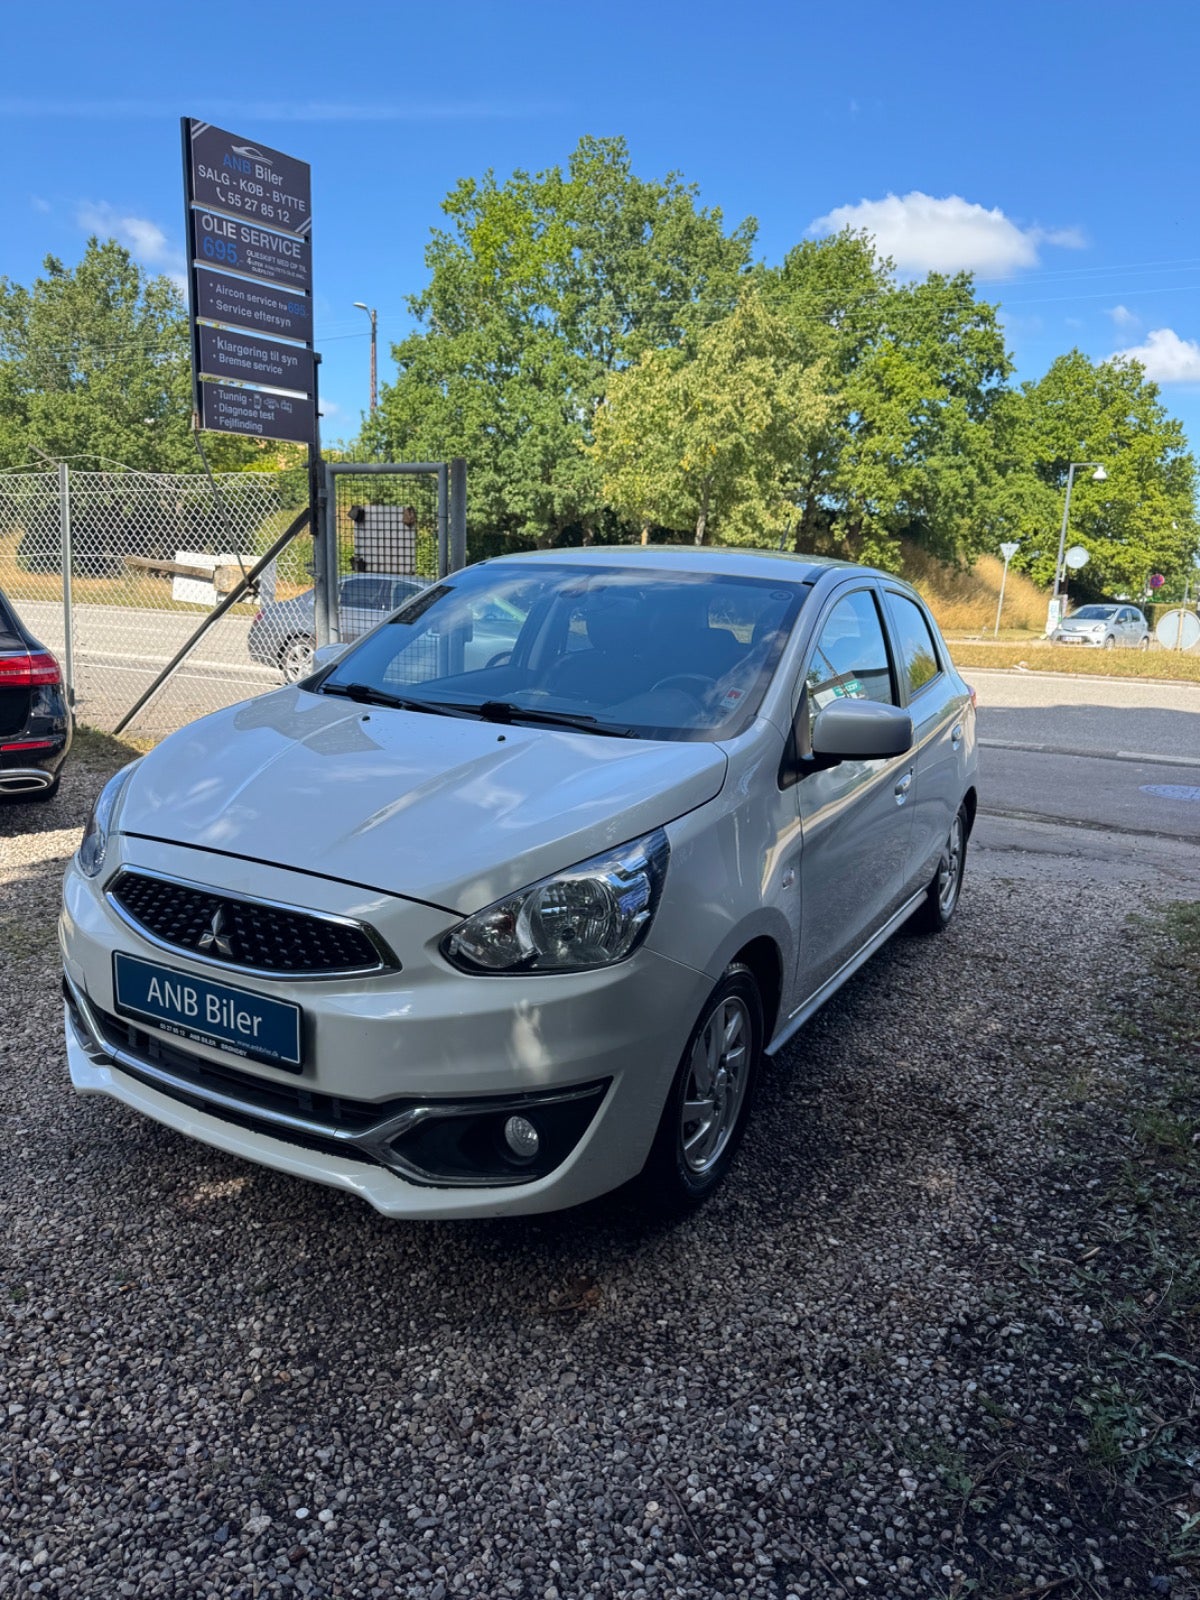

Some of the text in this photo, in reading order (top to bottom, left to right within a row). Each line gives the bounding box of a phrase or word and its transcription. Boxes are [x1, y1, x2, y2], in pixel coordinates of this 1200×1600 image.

[223, 153, 283, 186] ANB Biler
[198, 165, 230, 185] SALG
[240, 179, 263, 196] KØB
[273, 191, 306, 212] BYTTE
[228, 192, 290, 223] 55 27 85 12
[202, 214, 301, 258] OLIE SERVICE
[216, 284, 245, 300] Aircon
[247, 295, 277, 308] service
[278, 302, 287, 311] fra
[216, 301, 292, 327] Service eftersyn
[219, 354, 283, 375] Bremse service
[270, 350, 279, 361] til
[281, 354, 298, 366] syn
[219, 390, 247, 404] Tunnig
[219, 403, 275, 420] Diagnose test
[219, 416, 263, 433] Fejlfinding
[147, 976, 262, 1037] ANB Biler
[189, 1033, 200, 1041] ANB
[201, 1037, 216, 1046] BILER
